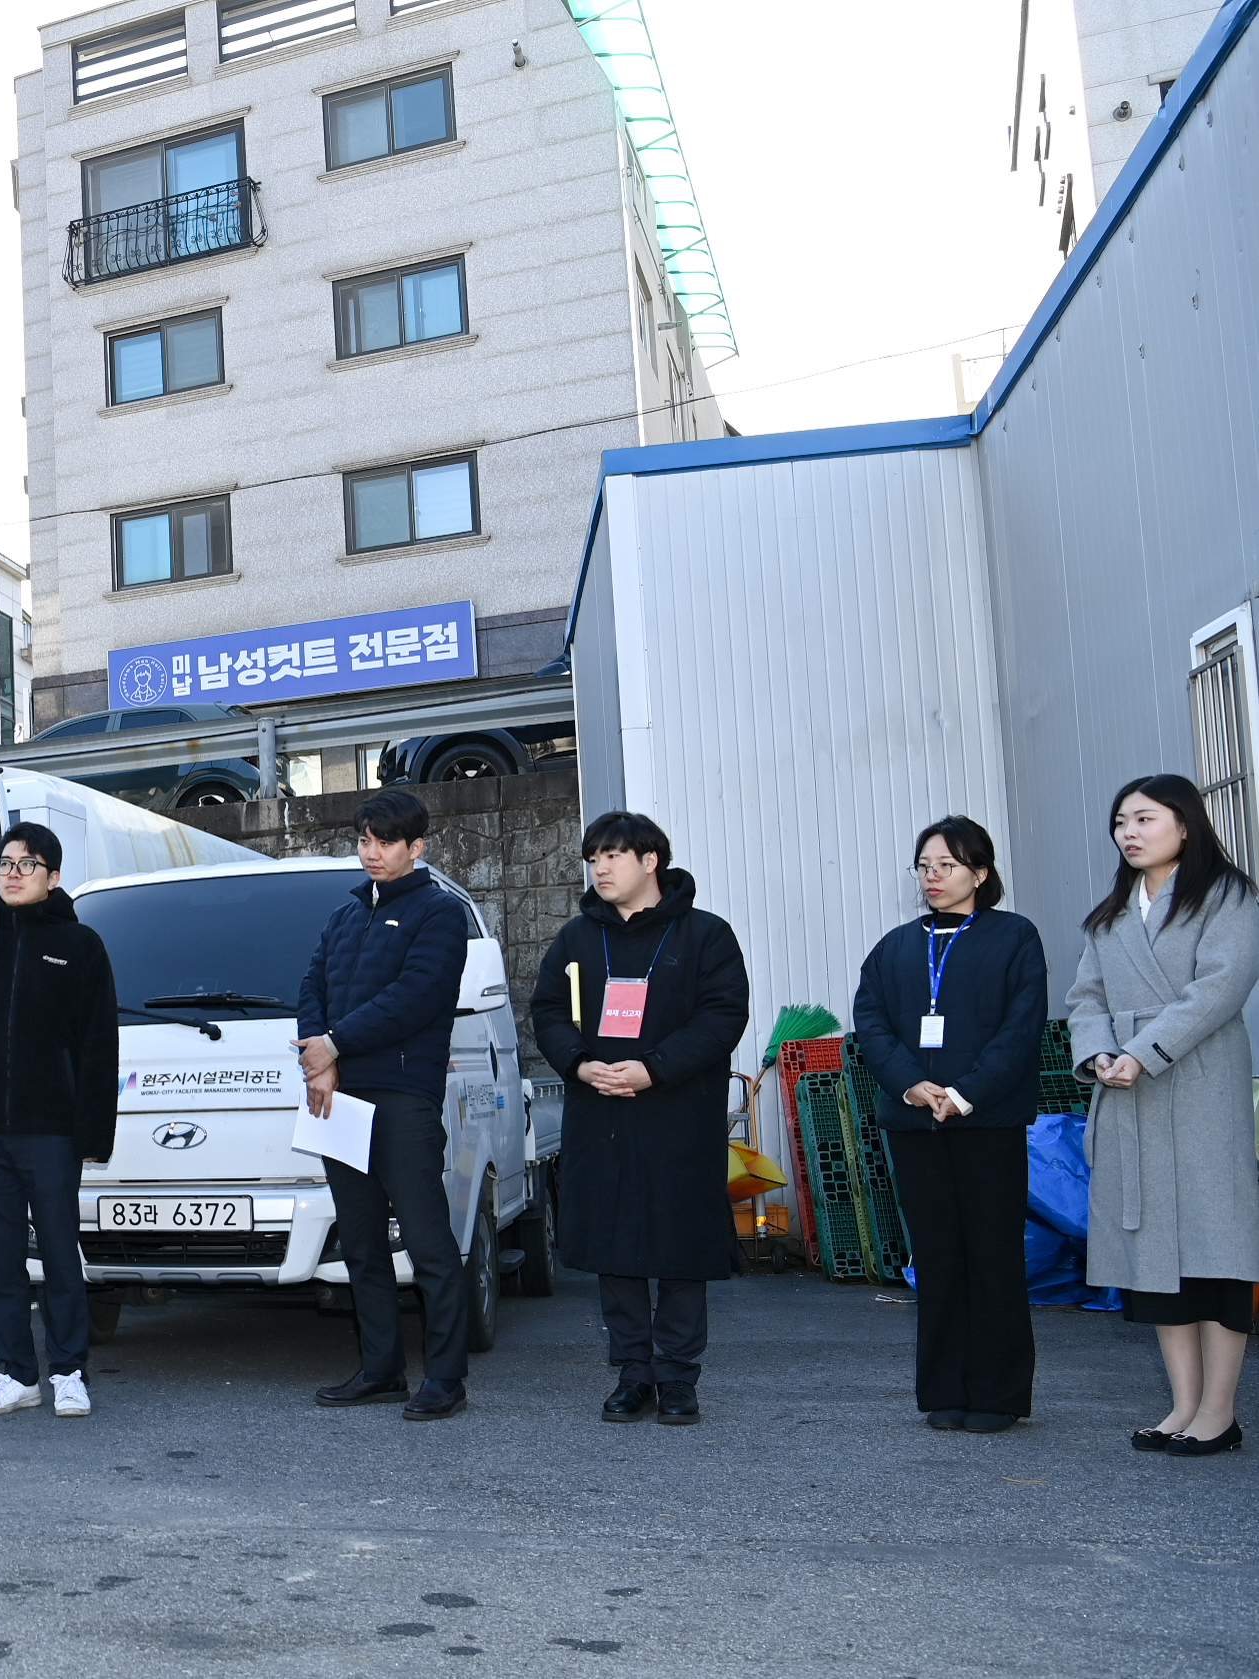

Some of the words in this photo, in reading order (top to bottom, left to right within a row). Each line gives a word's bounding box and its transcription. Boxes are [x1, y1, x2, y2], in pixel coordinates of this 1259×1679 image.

[197, 637, 338, 691] 남성컷트
[348, 621, 459, 671] 전문점
[621, 1008, 642, 1017] 신고자
[142, 1070, 283, 1088] 원주시시설관리공단
[112, 1203, 159, 1226] 83라
[172, 1202, 237, 1226] 6372
